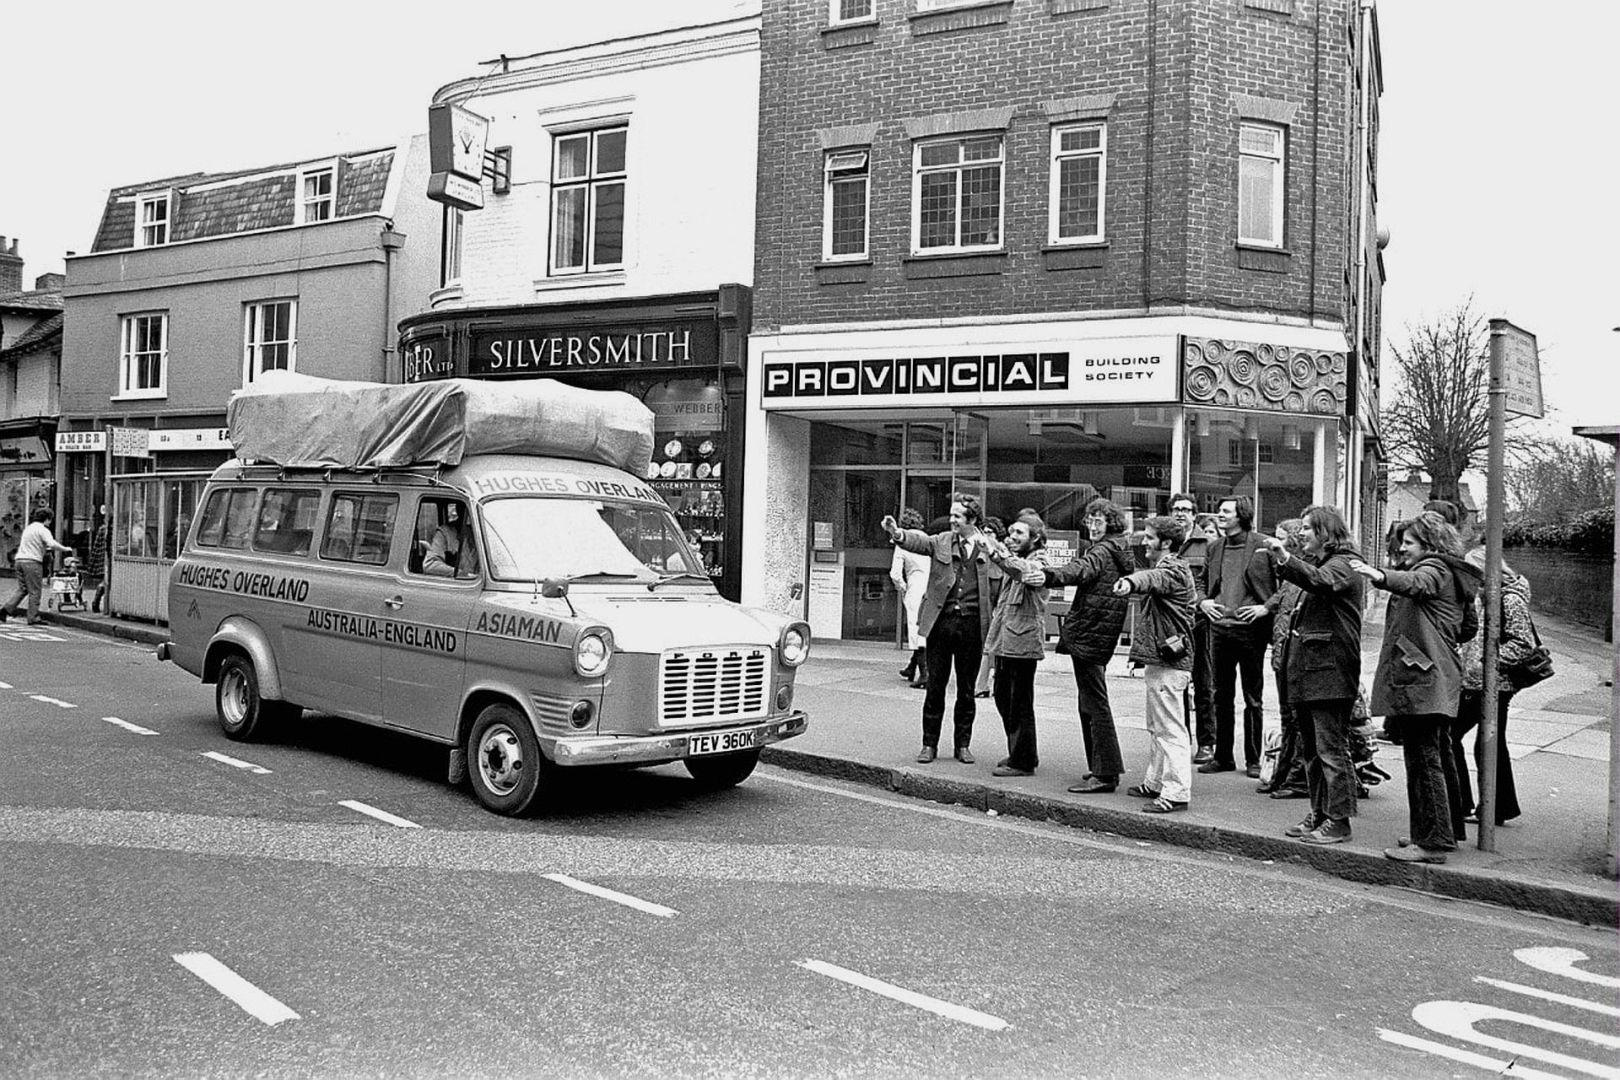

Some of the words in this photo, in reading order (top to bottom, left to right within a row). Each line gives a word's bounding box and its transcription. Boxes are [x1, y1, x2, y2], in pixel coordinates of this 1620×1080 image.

[490, 330, 692, 369] SILVERSMITH
[1085, 356, 1160, 367] BUILDING
[767, 357, 1067, 393] PROVINCIAL
[1085, 371, 1154, 381] SOCIETY
[674, 403, 721, 414] WEBBER
[59, 433, 100, 444] AMBER
[218, 429, 231, 441] EA
[477, 477, 569, 495] HUGHES
[575, 479, 665, 505] OVERLAND
[649, 482, 693, 490] NGAGEMENT
[179, 564, 229, 591] HUGHES
[233, 570, 310, 603] OVERLAND
[307, 609, 457, 653] AUSTRALIA-ENGLAND
[476, 611, 563, 643] ASIAMAN
[673, 650, 761, 658] FORD
[692, 736, 719, 752] TEV
[722, 732, 754, 749] 360K
